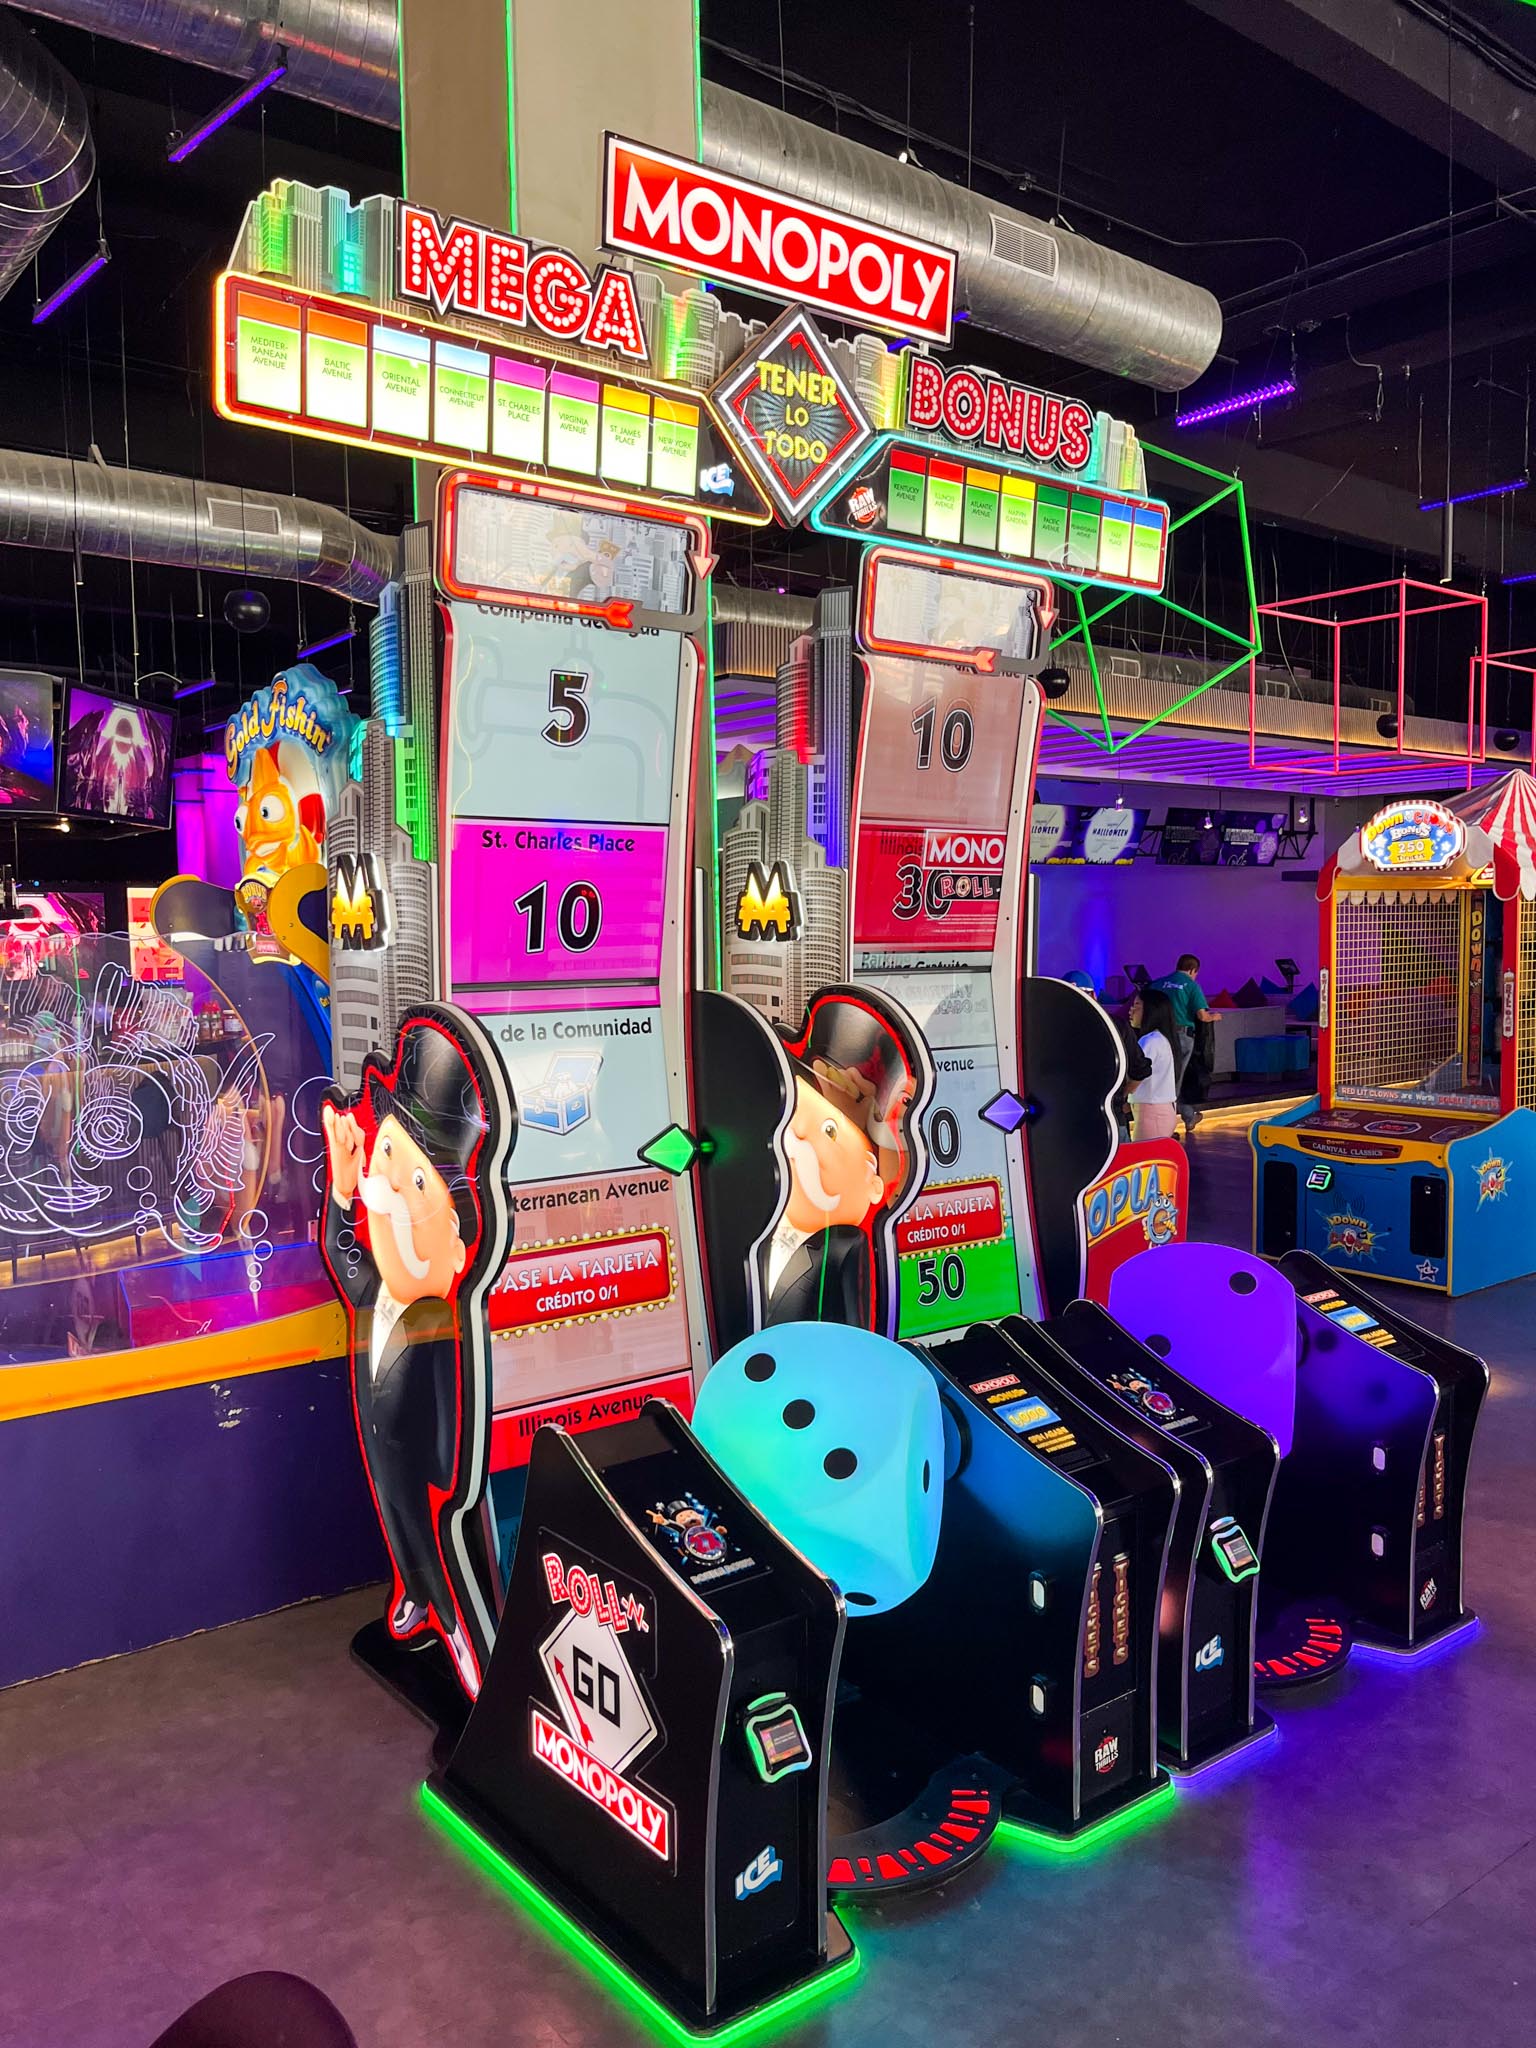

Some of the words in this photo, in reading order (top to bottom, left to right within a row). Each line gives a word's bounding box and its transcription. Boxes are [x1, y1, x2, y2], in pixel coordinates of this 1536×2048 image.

[623, 163, 945, 321] MONOPOLY
[402, 204, 649, 361] MEGA
[250, 336, 288, 351] MEDITER-
[252, 346, 288, 360] RANEAN
[253, 356, 286, 370] AVENUE
[324, 357, 350, 371] BALTIC
[322, 368, 352, 381] AVENUE
[381, 371, 421, 387] ORIENTAL
[756, 360, 839, 406] TENER
[385, 382, 417, 396] AVENUE
[440, 385, 485, 402] CONNECTICUT
[448, 396, 475, 409] AVENUE
[509, 400, 541, 415] CHARLES
[508, 410, 530, 422] PLACE
[558, 413, 589, 426] VIRGINIA
[785, 405, 809, 426] LO
[908, 360, 1093, 469] BONUS
[560, 423, 587, 435] AVENUE
[621, 427, 641, 438] JAMES
[614, 435, 635, 446] PLACE
[658, 436, 673, 446] NEW
[674, 439, 692, 449] YORK
[764, 432, 828, 465] TODO
[662, 446, 687, 457] AVENUE
[894, 483, 920, 494] KENTUCKY
[896, 490, 916, 502] AVENUE
[848, 487, 875, 513] RAW
[970, 500, 993, 511] ATLANTIC
[971, 508, 991, 518] AVENUE
[1043, 516, 1060, 525] PACIFIC
[1042, 523, 1060, 533] AVENUE
[541, 670, 591, 747] 5
[225, 699, 260, 780] Gold
[911, 698, 974, 772] 10
[482, 830, 508, 849] St.
[515, 831, 583, 851] Charles
[588, 833, 636, 852] Place
[1390, 822, 1432, 841] BONUS
[1398, 841, 1425, 853] 250
[514, 880, 603, 954] 10
[500, 1023, 525, 1042] de
[531, 1022, 547, 1040] la
[553, 1017, 653, 1039] Comunidad
[936, 1058, 975, 1073] venue
[1341, 1087, 1355, 1096] RED
[1356, 1088, 1368, 1097] LIT
[1369, 1089, 1399, 1100] CLOWNS
[1400, 1092, 1413, 1101] are
[1312, 1142, 1347, 1155] CARNIVAL
[1350, 1147, 1384, 1158] CLASSICS
[513, 1188, 599, 1213] terranean
[606, 1179, 670, 1200] Avenue
[915, 1203, 934, 1222] LA
[936, 1196, 994, 1218] TARJETA
[907, 1226, 949, 1244] CRÉDITO
[951, 1223, 966, 1237] 0/1
[548, 1264, 575, 1285] LA
[578, 1249, 659, 1280] TARJETA
[917, 1253, 966, 1306] 50
[536, 1287, 596, 1313] CRÉDITO
[598, 1285, 619, 1301] 0/1
[1434, 1434, 1445, 1515] TICKETS
[543, 1553, 630, 1633] ROLL
[1115, 1561, 1127, 1659] TICKETS
[1195, 1634, 1223, 1672] ICE
[572, 1643, 621, 1728] GO
[1095, 1737, 1118, 1763] RAW
[1096, 1749, 1119, 1772] THRILLS
[538, 1719, 663, 1845] MONOPOLY
[735, 1845, 782, 1899] ICE
